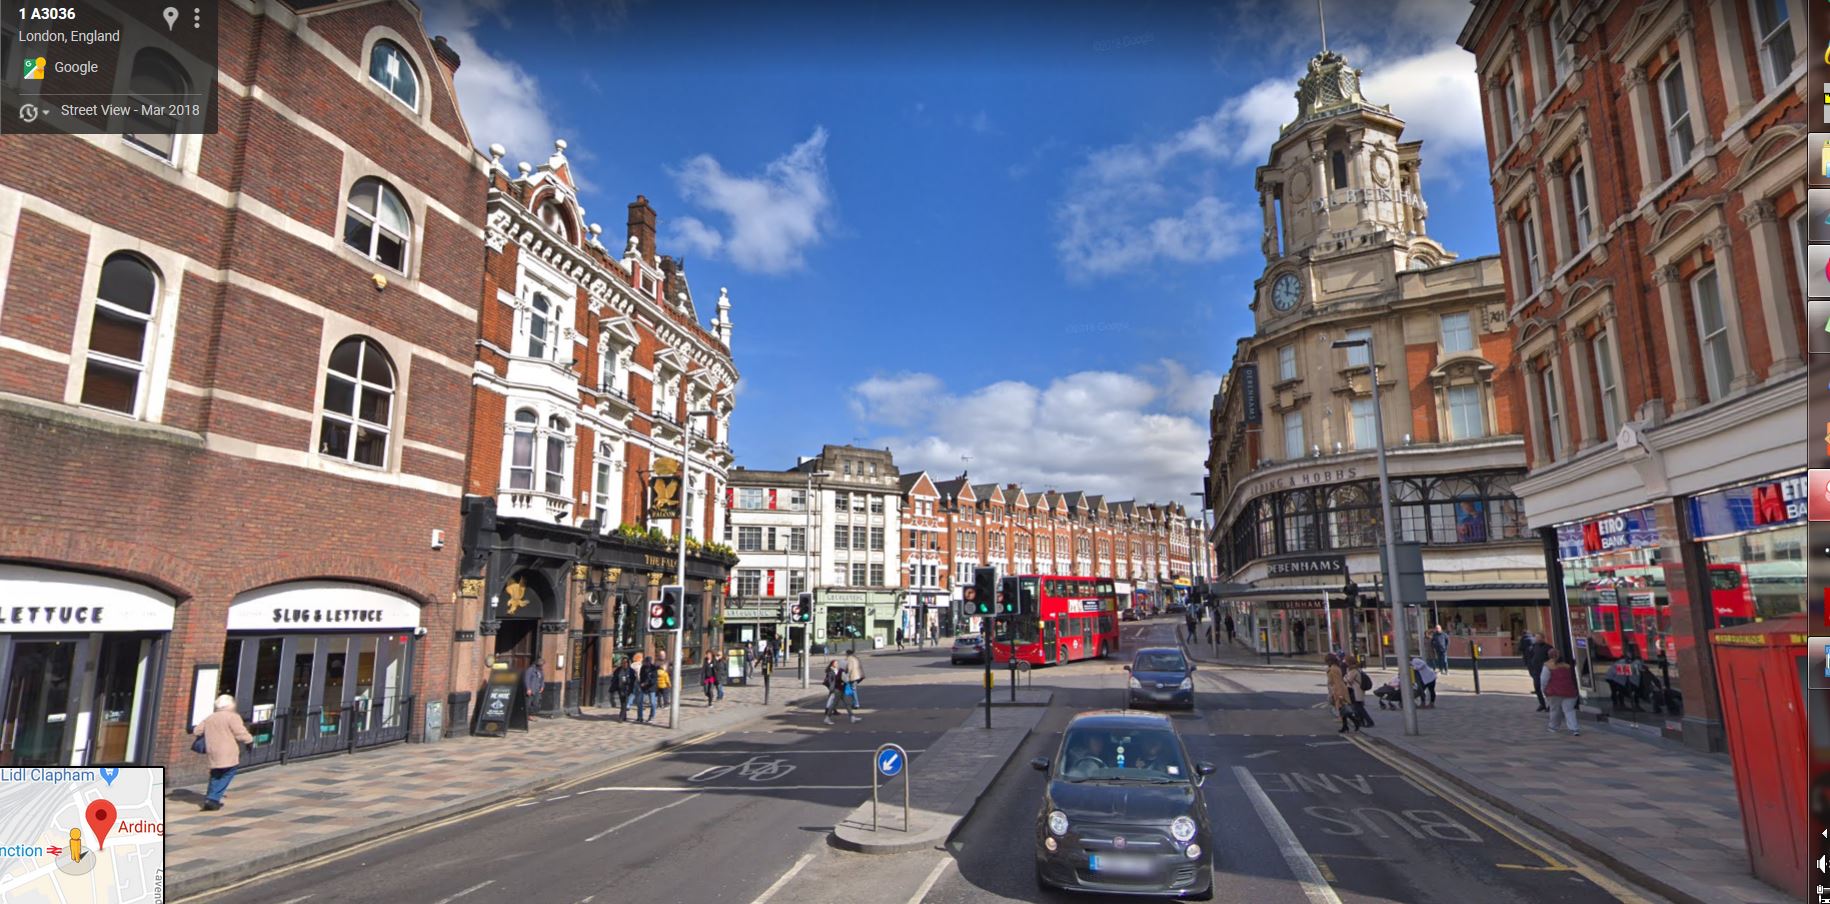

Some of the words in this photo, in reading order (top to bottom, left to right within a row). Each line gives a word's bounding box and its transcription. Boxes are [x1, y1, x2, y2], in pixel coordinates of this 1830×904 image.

[1246, 369, 1256, 420] DEBENHAMS
[1302, 467, 1357, 485] HOBBS
[1583, 516, 1625, 552] METRO
[1601, 534, 1630, 549] BANK
[645, 554, 660, 567] THE
[1267, 561, 1341, 575] DEBENHAMS
[273, 608, 309, 623] SLUG
[314, 609, 322, 622] &
[326, 609, 384, 622] LETTUCE
[1304, 805, 1484, 843] BUS
